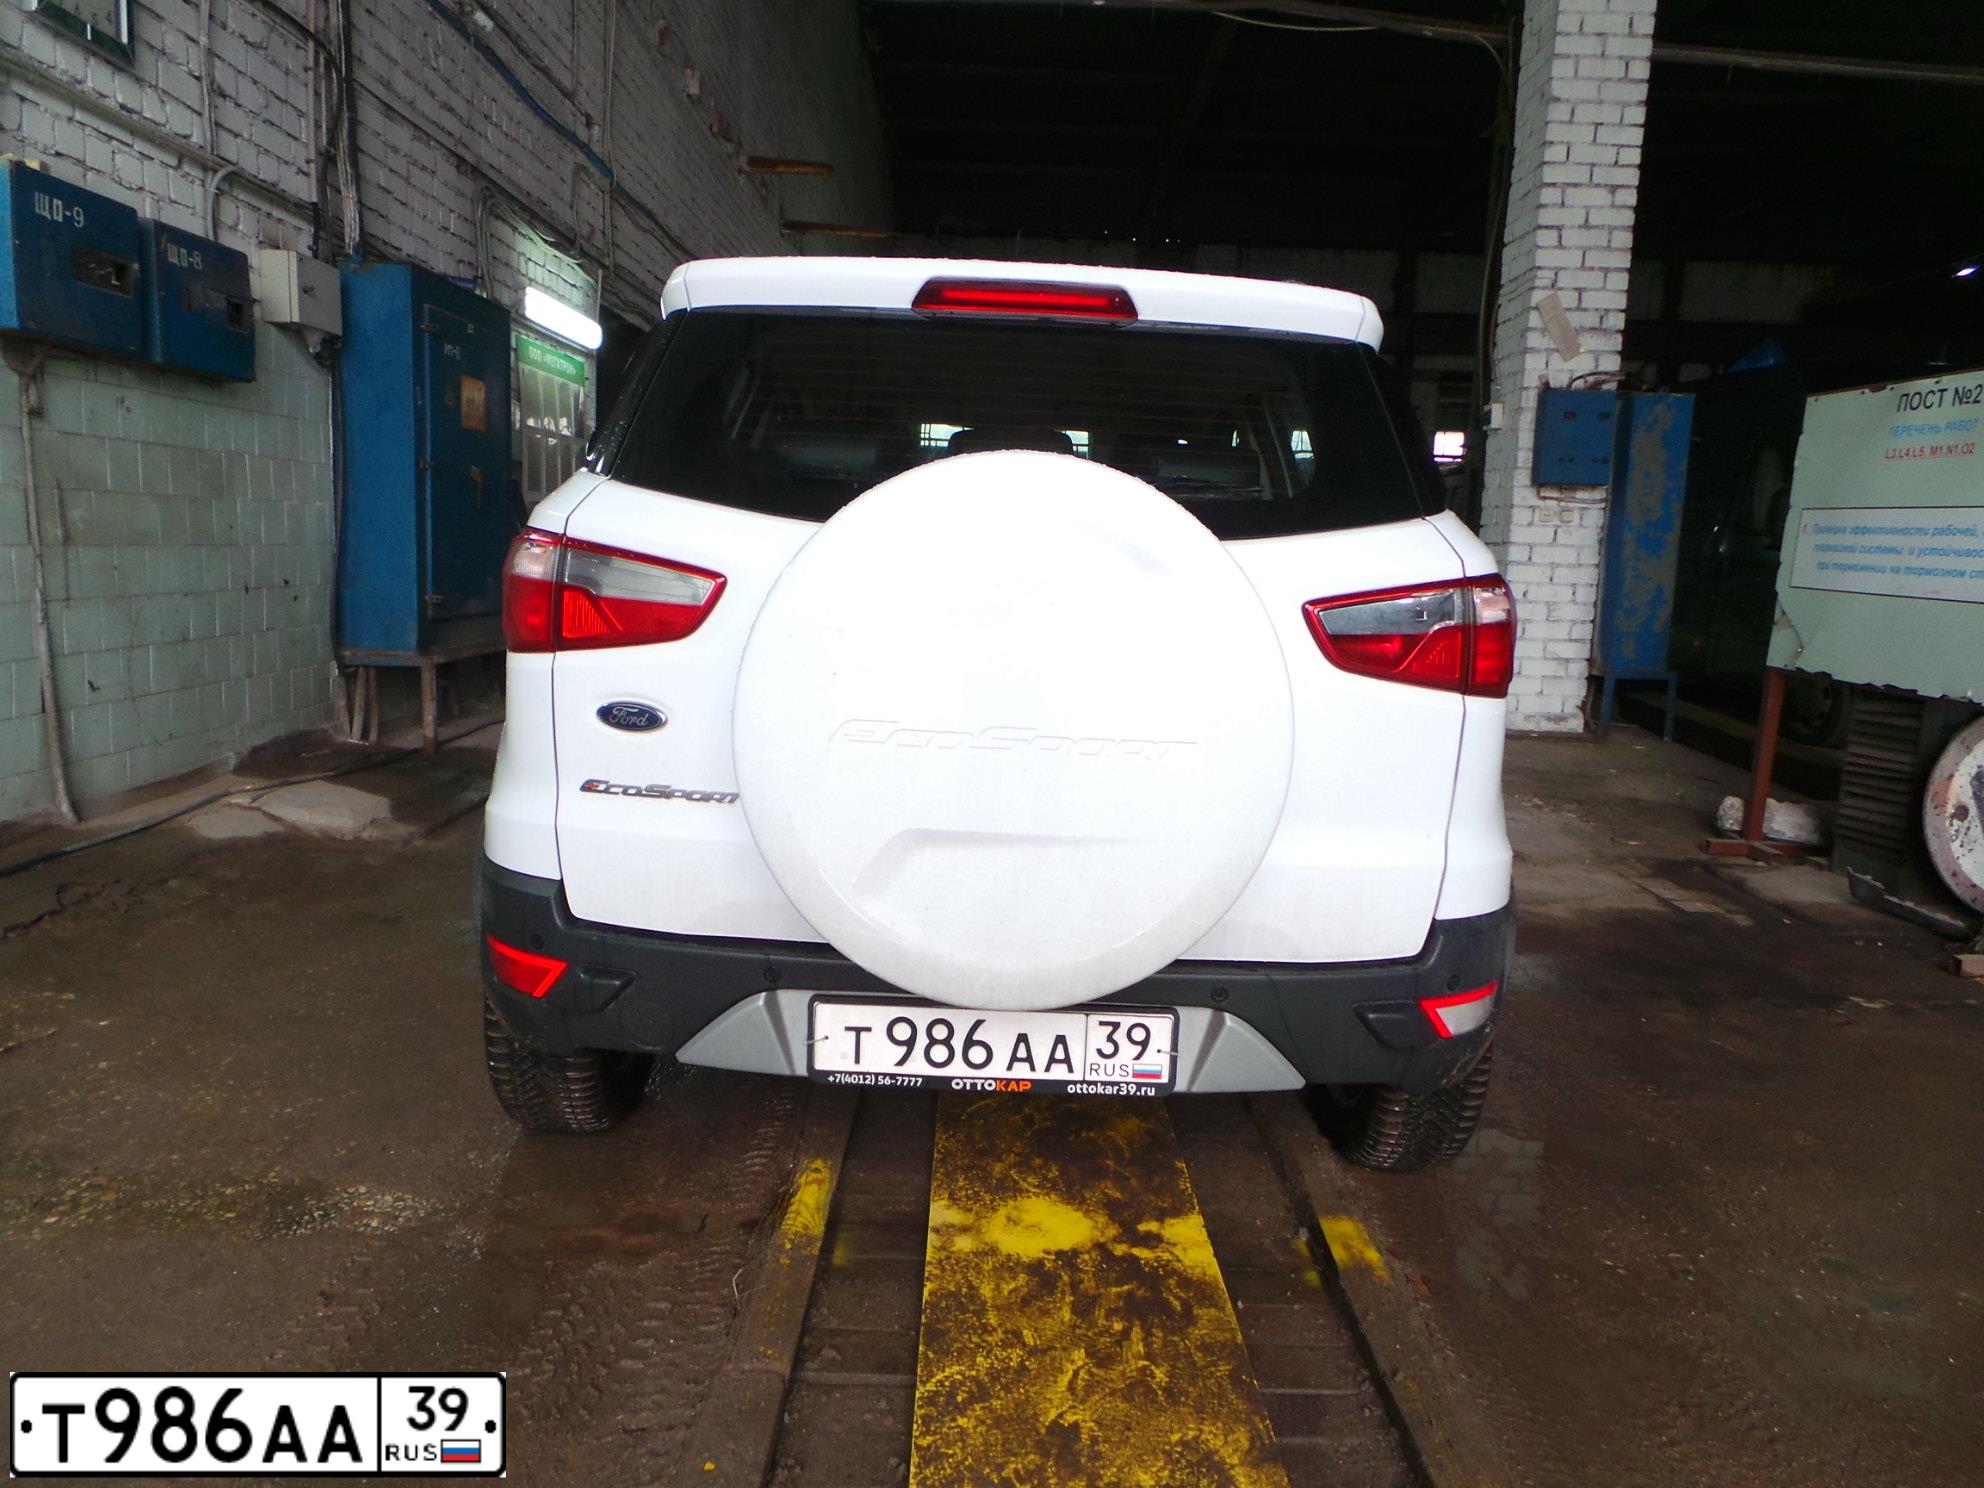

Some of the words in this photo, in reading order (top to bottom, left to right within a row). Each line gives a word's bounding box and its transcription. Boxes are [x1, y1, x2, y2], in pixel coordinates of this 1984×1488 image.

[528, 345, 542, 361] ООО
[1896, 387, 1948, 412] ПОСТ
[1951, 384, 1984, 407] №2
[609, 705, 649, 728] Ford
[1096, 1020, 1152, 1061] 39
[1089, 1063, 1130, 1078] RUS
[827, 1073, 876, 1086] +7(4012)
[877, 1075, 923, 1087] 56-7777
[1067, 1082, 1156, 1096] ottokar39.ru
